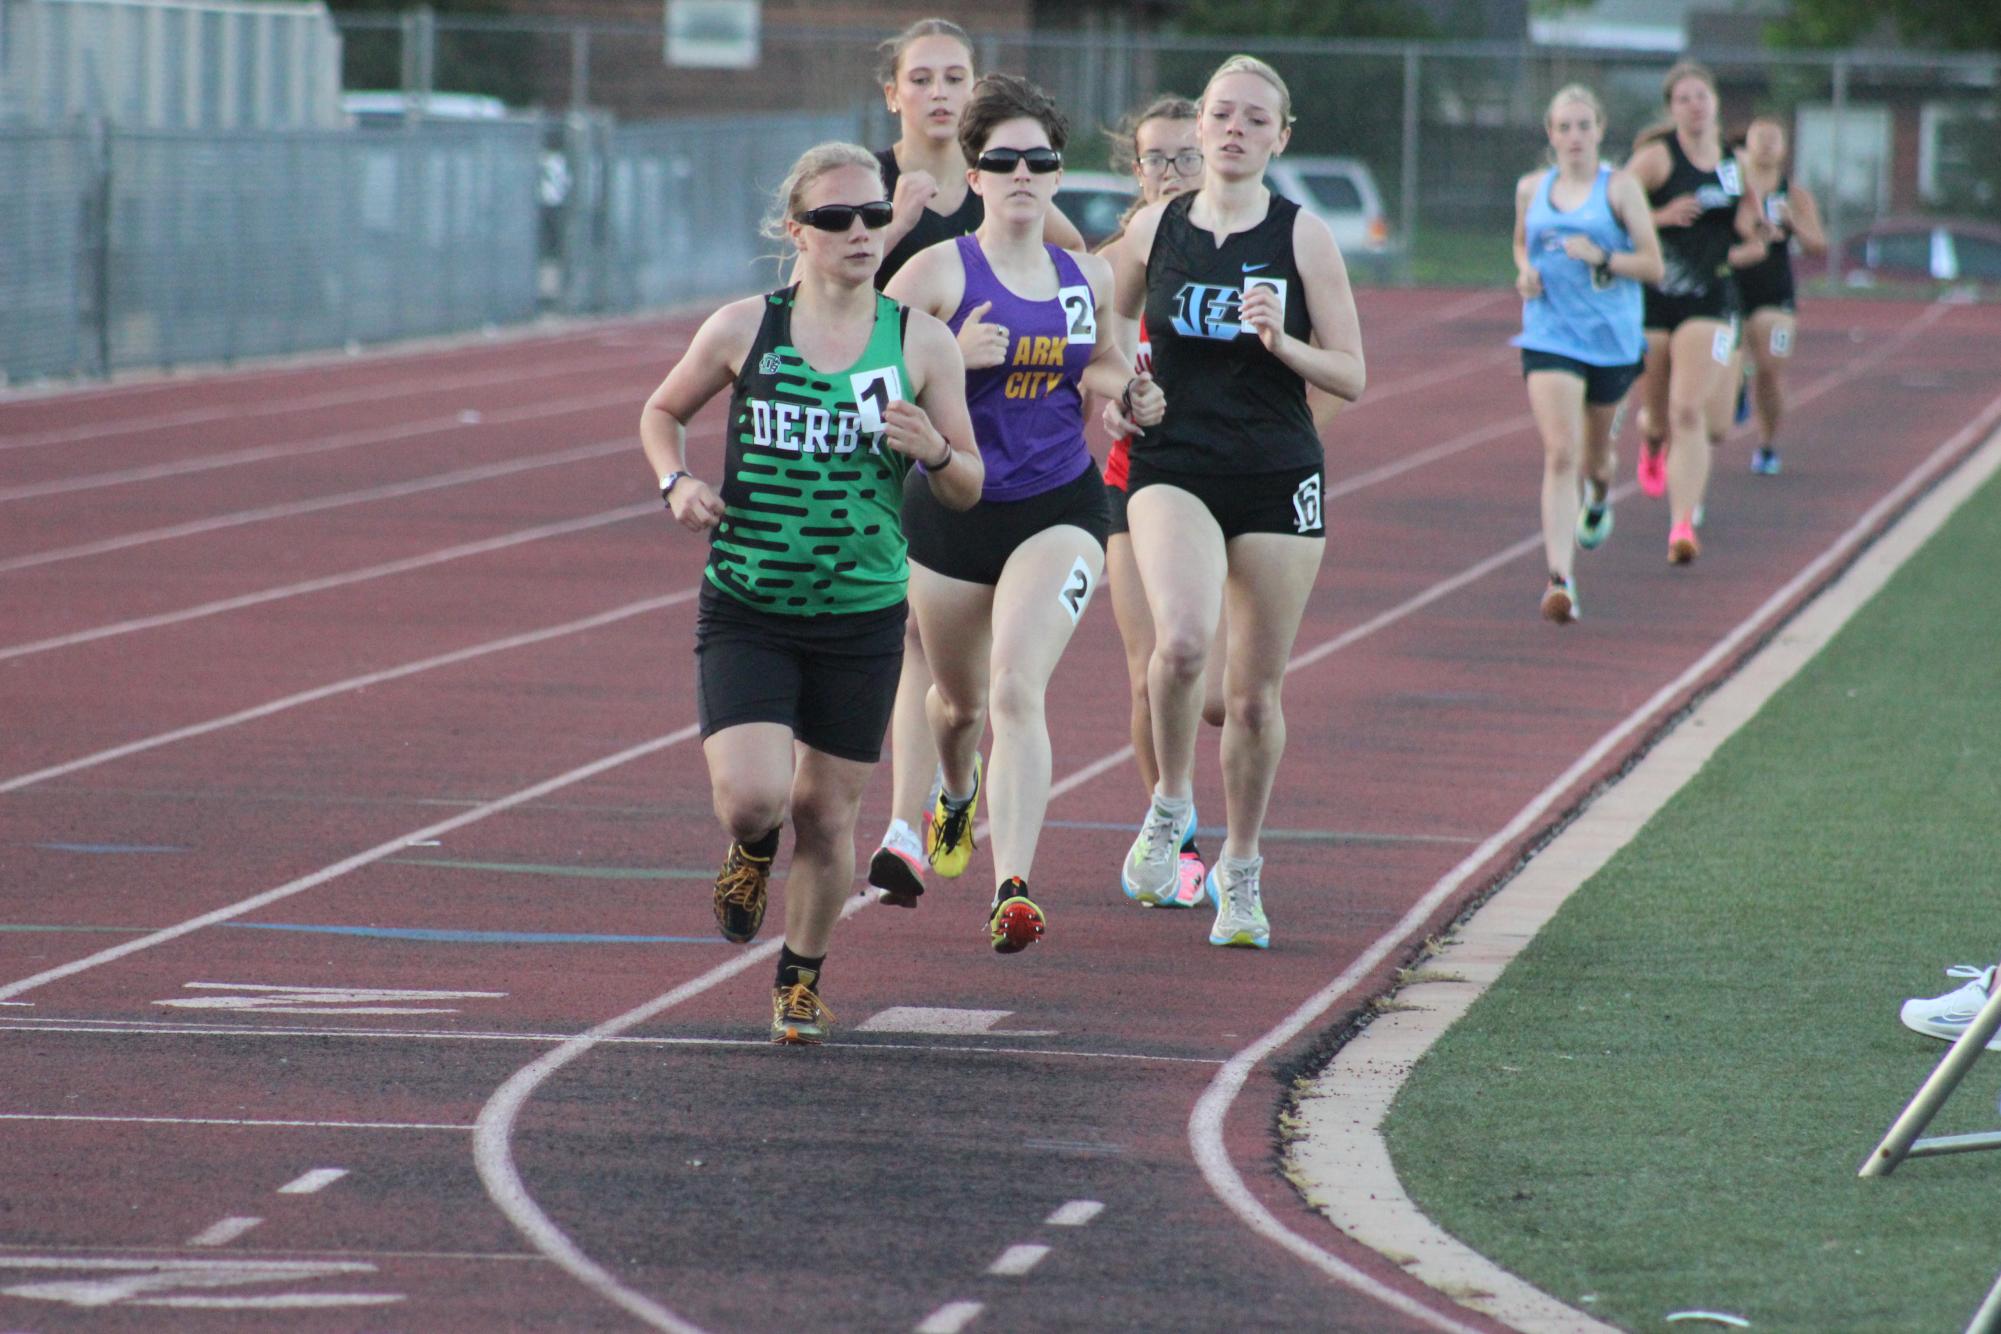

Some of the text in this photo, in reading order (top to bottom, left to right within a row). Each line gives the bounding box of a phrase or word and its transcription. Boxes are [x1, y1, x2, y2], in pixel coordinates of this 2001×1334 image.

[1065, 295, 1092, 335] 2
[1012, 336, 1069, 367] ARK
[860, 376, 890, 424] 1
[1004, 371, 1065, 400] CITY
[1297, 481, 1318, 527] 6
[1063, 569, 1088, 614] 2
